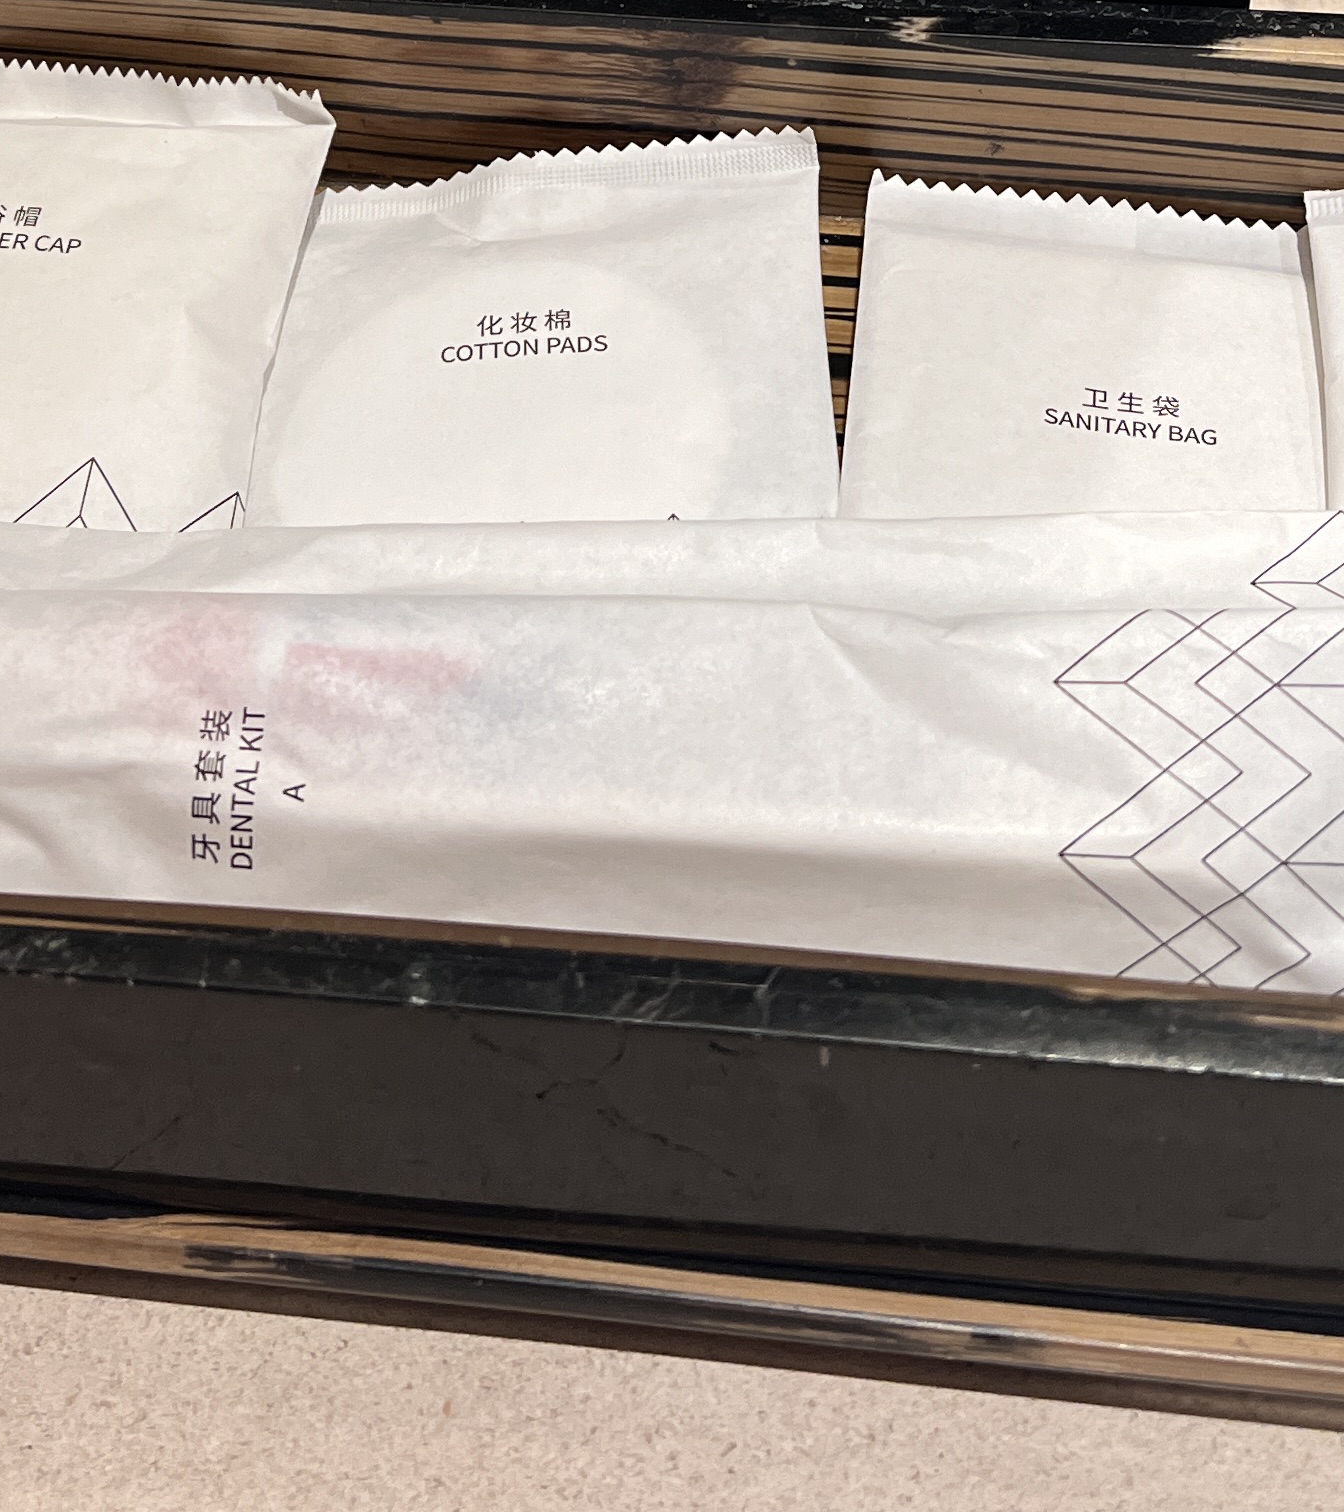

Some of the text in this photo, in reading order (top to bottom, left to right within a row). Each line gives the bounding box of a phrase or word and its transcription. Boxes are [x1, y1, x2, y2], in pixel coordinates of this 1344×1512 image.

[34, 234, 82, 254] CAP
[476, 308, 571, 337] 化妆棉
[441, 334, 608, 363] COTTON PADS
[1081, 387, 1180, 418] 卫生袋
[1044, 408, 1217, 446] SANITARY BAG
[191, 710, 233, 865] 牙具套装
[229, 706, 266, 870] DENTAL KIT
[282, 783, 306, 802] A
